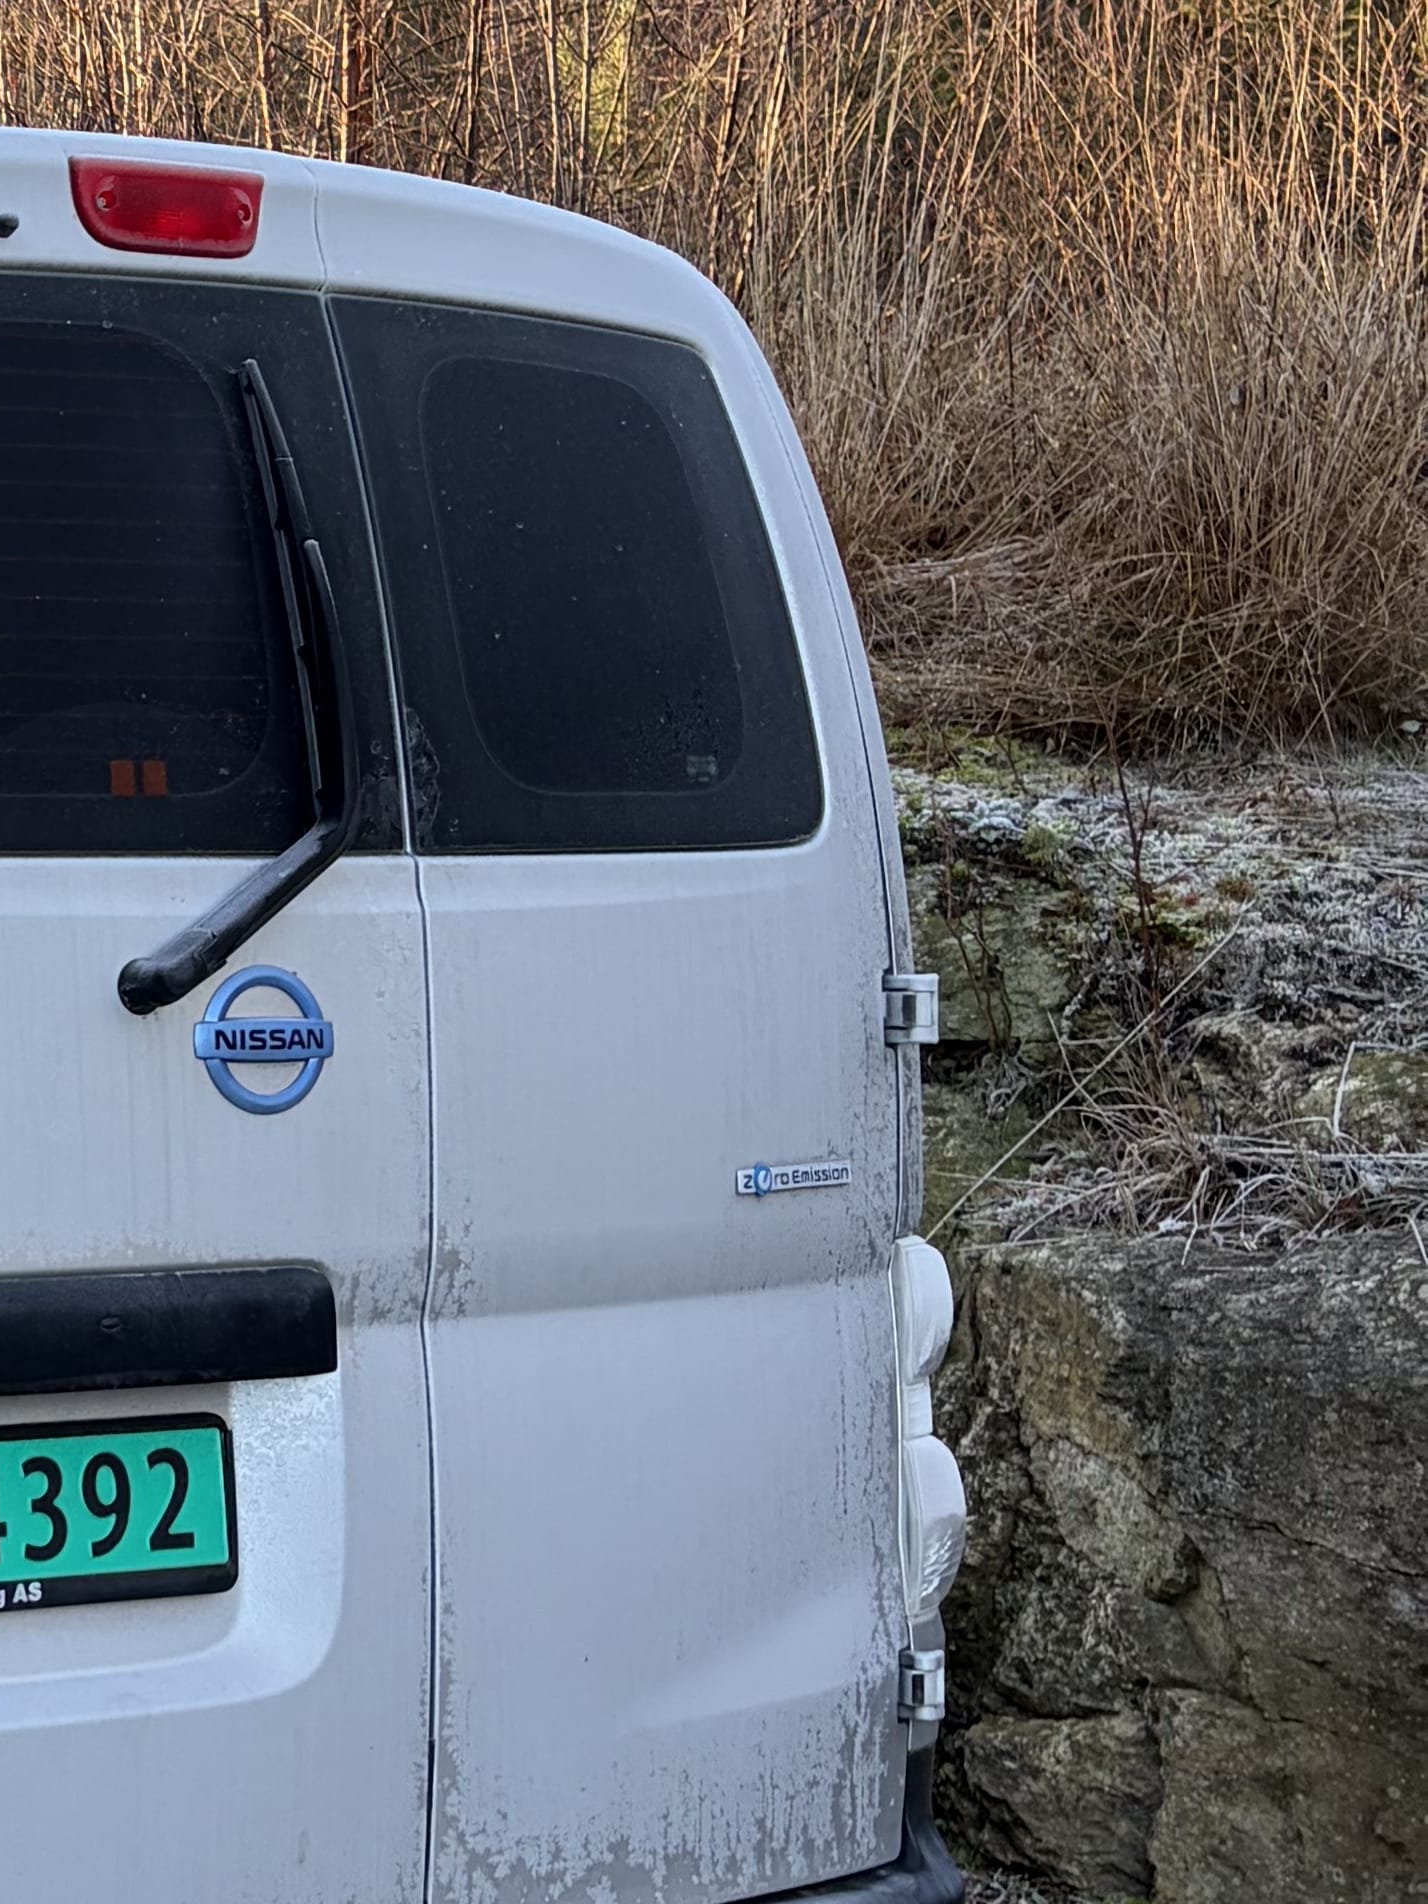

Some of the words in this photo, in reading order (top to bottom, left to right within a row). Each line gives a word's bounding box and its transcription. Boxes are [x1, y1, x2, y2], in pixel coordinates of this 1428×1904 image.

[214, 1028, 324, 1051] NISSAN
[791, 1165, 849, 1185] Emission
[12, 1581, 43, 1604] AS
